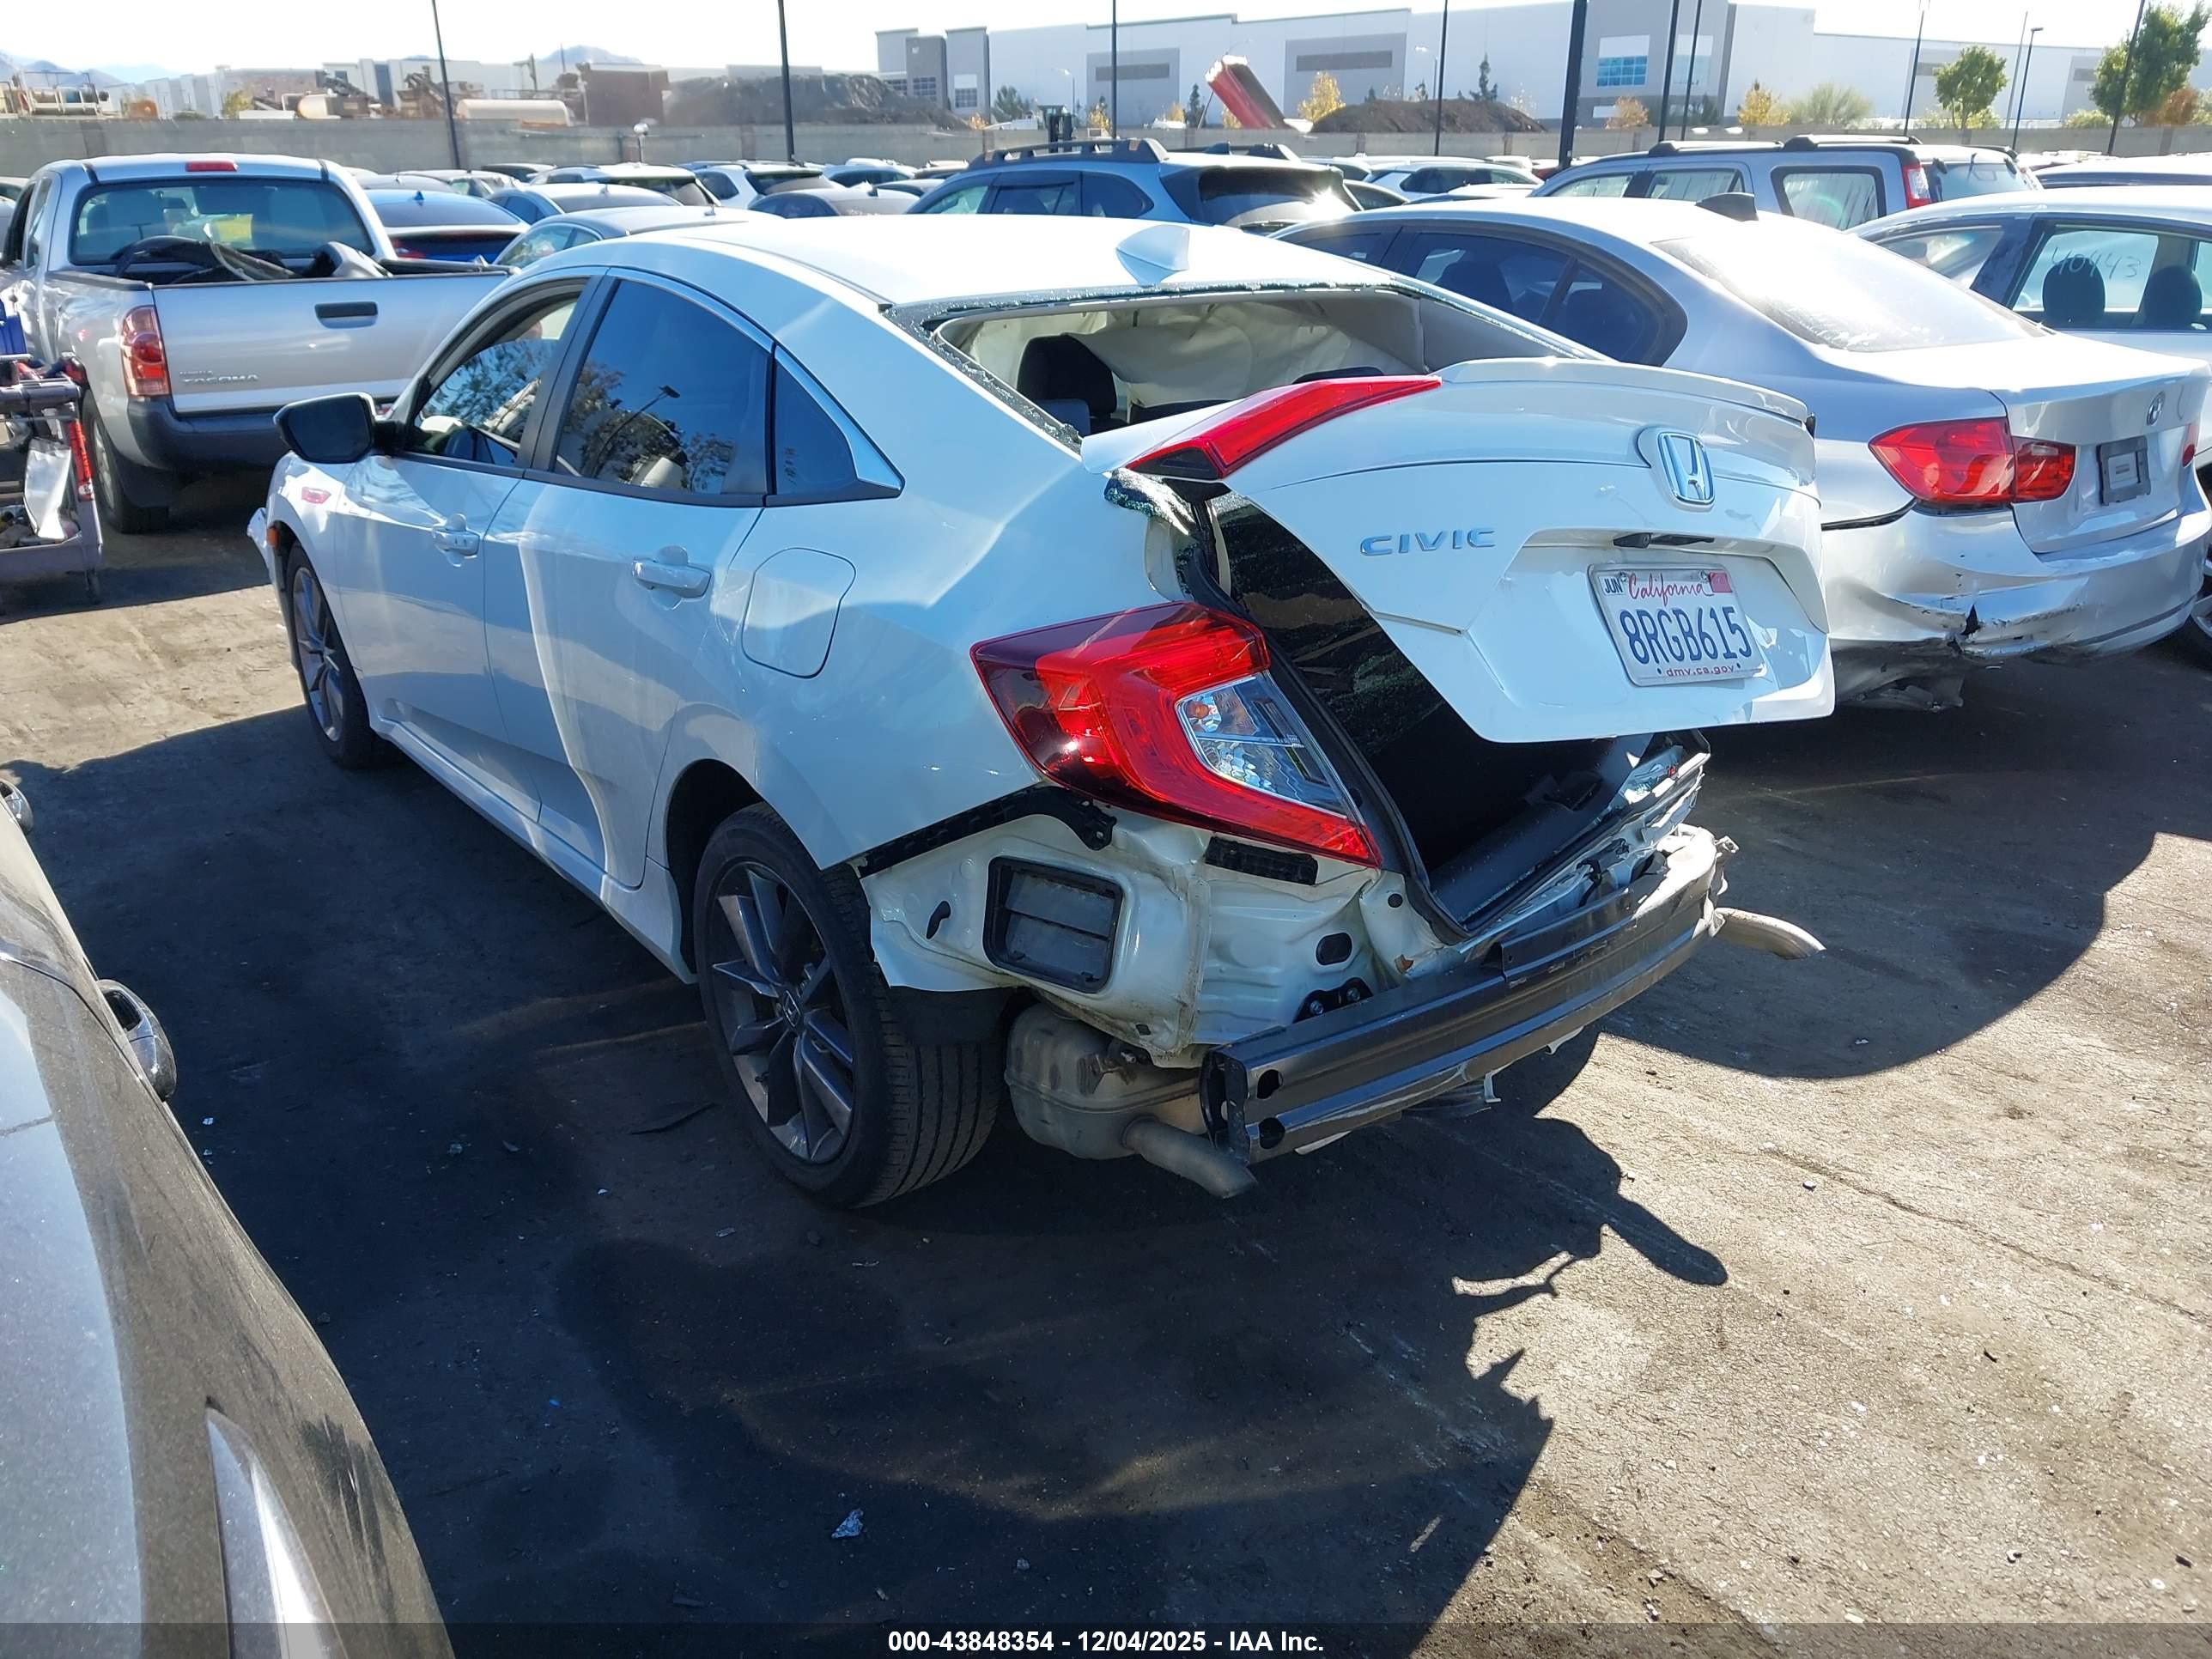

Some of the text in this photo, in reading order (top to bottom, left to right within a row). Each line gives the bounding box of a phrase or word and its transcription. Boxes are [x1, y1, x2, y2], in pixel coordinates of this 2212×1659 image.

[1360, 529, 1497, 556] CIVIC
[1604, 577, 1624, 593] JUN
[1628, 572, 1715, 606] California
[1620, 605, 1753, 665] 8RGB615
[1666, 665, 1735, 677] dmv.ca.gov
